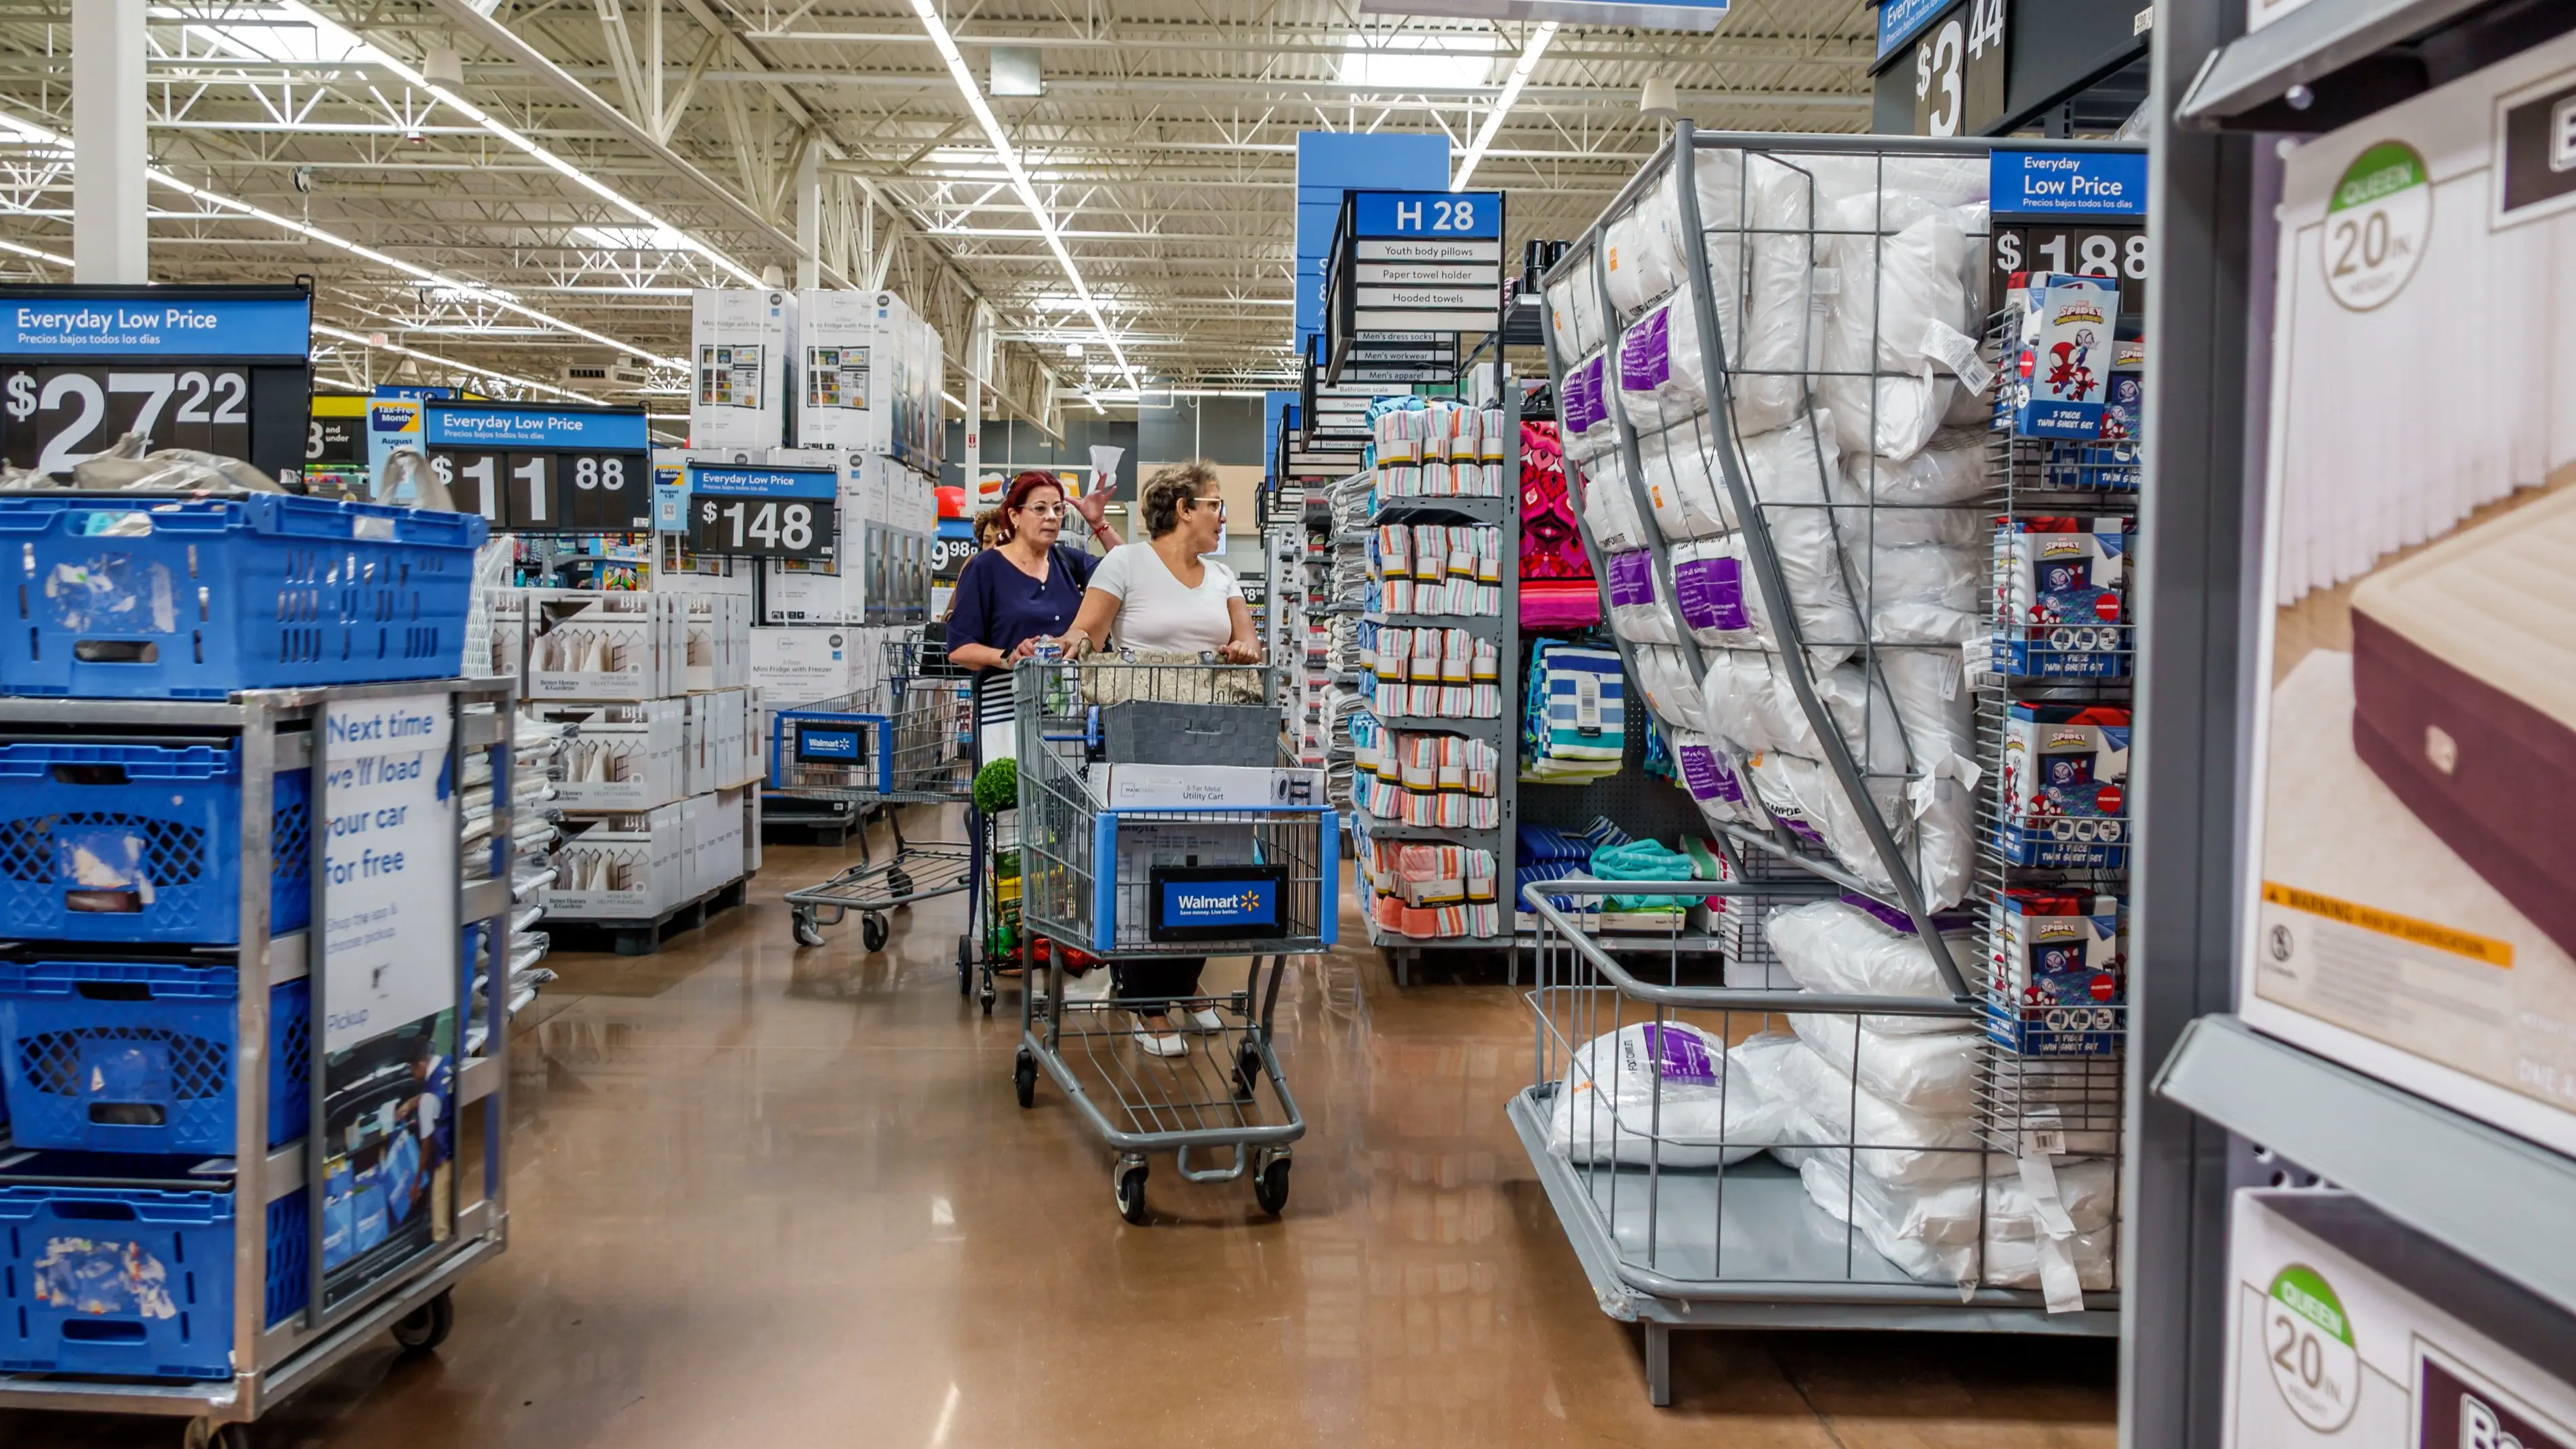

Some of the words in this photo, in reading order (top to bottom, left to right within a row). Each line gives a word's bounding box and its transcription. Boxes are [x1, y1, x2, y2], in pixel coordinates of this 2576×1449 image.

[2024, 157, 2080, 172] Everyday
[2025, 175, 2065, 195] Low
[2072, 176, 2122, 196] Price
[2342, 161, 2413, 205] QUEEN
[2023, 198, 2053, 207] Precios
[2055, 199, 2076, 210] bajos
[2078, 200, 2101, 208] todos
[1397, 201, 1422, 231] H
[1432, 201, 1474, 231] 28
[2333, 209, 2391, 279] 20
[1386, 245, 1412, 256] Youth
[1415, 245, 1438, 258] body
[1441, 247, 1473, 258] pillows
[1383, 270, 1409, 281] Paper
[1413, 270, 1438, 279] towel
[1442, 270, 1472, 280] holder
[1393, 293, 1430, 303] Hooded
[1433, 294, 1464, 303] towels
[2059, 305, 2104, 317] SPIDEY
[18, 309, 113, 334] Everyday
[119, 309, 161, 330] Low
[165, 309, 217, 330] Price
[717, 321, 736, 329] Fridge
[824, 322, 842, 330] Fridge
[18, 334, 58, 344] Precios
[60, 333, 87, 347] bajos
[89, 334, 119, 344] todos
[122, 334, 137, 344] los
[1363, 332, 1386, 340] Men's
[1388, 332, 1408, 340] dress
[1410, 332, 1432, 340] socks
[1365, 351, 1388, 359] Men's
[1390, 352, 1428, 360] workwear
[1369, 371, 1393, 379] Men's
[1395, 372, 1424, 381] apparel
[378, 405, 416, 414] Tax-Free
[2060, 411, 2082, 420] PIECE
[325, 425, 340, 433] and
[443, 414, 512, 432] Everyday
[515, 416, 544, 430] Low
[548, 417, 583, 431] Price
[2037, 419, 2055, 427] TWIN
[2057, 420, 2079, 429] SHEET
[2080, 421, 2094, 429] SET
[445, 429, 472, 438] Precios
[475, 430, 493, 440] bajos
[518, 431, 529, 439] los
[382, 437, 412, 445] August
[703, 473, 746, 485] Everyday
[749, 475, 767, 484] Low
[771, 475, 794, 485] Price
[703, 500, 813, 550] $148
[2045, 541, 2079, 551] SPIDEY
[769, 665, 790, 674] Fridge
[2090, 663, 2104, 671] ST
[622, 706, 643, 719] BH
[327, 713, 382, 744] Next
[388, 710, 433, 738] time
[2052, 732, 2085, 741] SPIDEY
[809, 738, 839, 748] Walmart
[326, 757, 371, 789] we'll
[378, 751, 423, 783] load
[1183, 792, 1206, 801] Utility
[1208, 792, 1224, 800] Cart
[375, 803, 409, 829] car
[324, 856, 356, 886] for
[361, 848, 405, 877] free
[1178, 895, 1238, 909] Walmart
[353, 913, 369, 926] the
[371, 907, 388, 924] app
[2040, 924, 2074, 933] SPIDEY
[327, 1009, 370, 1031] Pickup
[2280, 1280, 2342, 1338] QUEEN
[2273, 1315, 2322, 1389] 20
